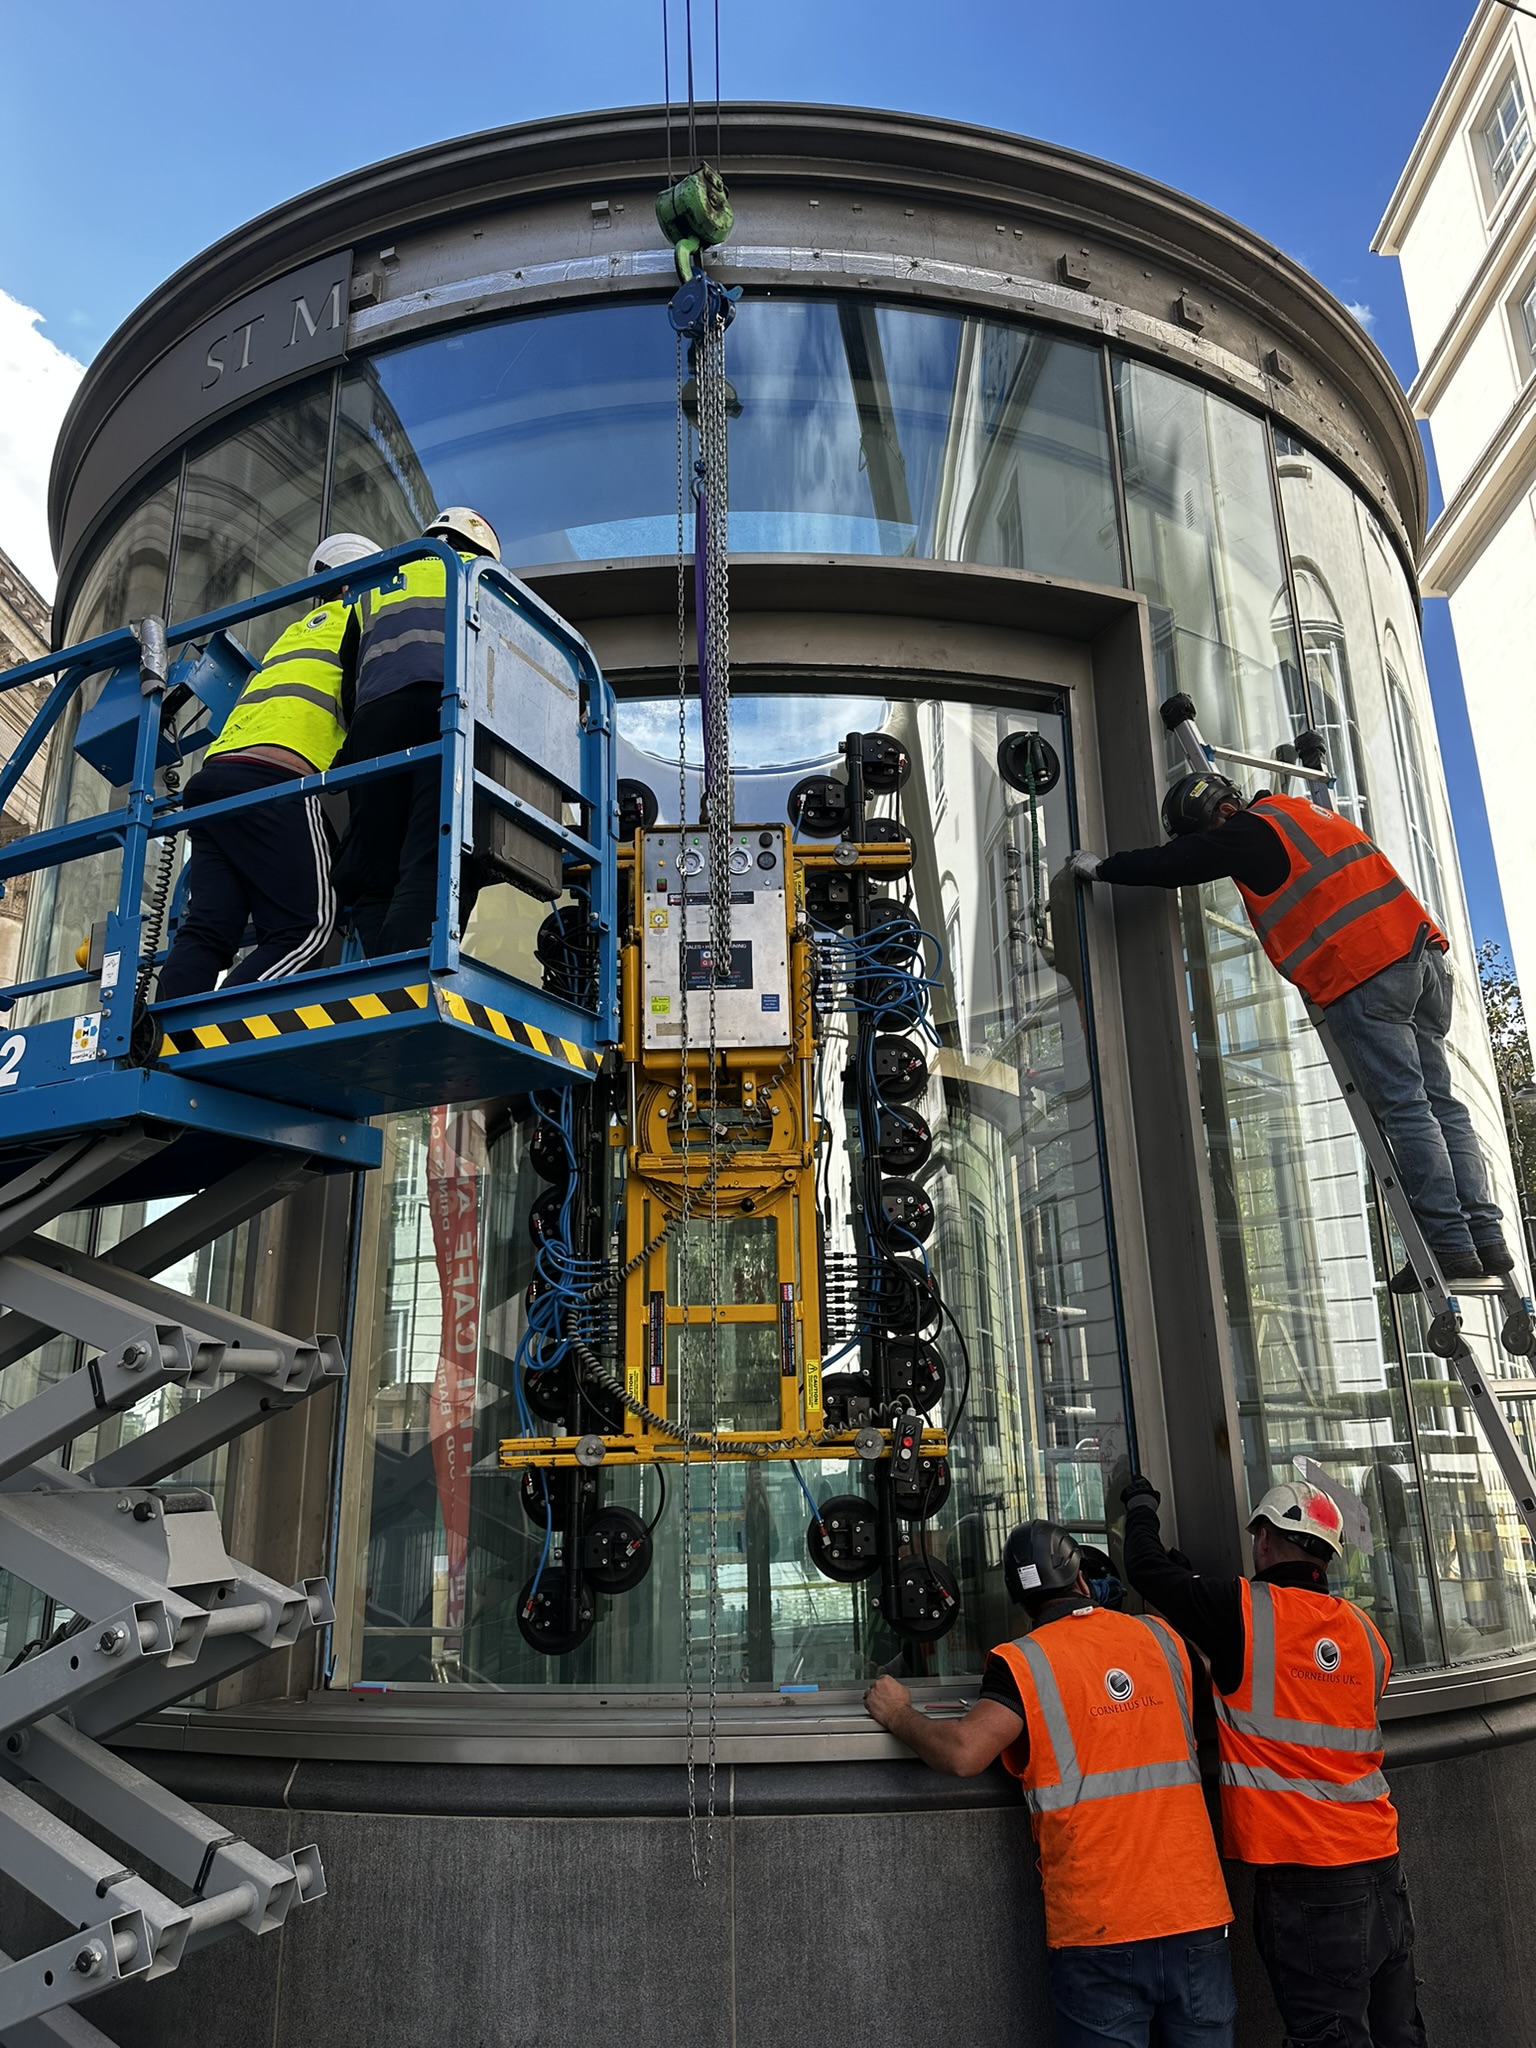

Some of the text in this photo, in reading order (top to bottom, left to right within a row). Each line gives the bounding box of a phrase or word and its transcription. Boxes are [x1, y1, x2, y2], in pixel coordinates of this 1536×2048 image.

[201, 278, 345, 392] ST M
[0, 1034, 27, 1087] 2
[1290, 1667, 1355, 1685] CORNELIUS UK
[1089, 1700, 1139, 1717] CORNELIUS
[1141, 1696, 1157, 1707] UK
